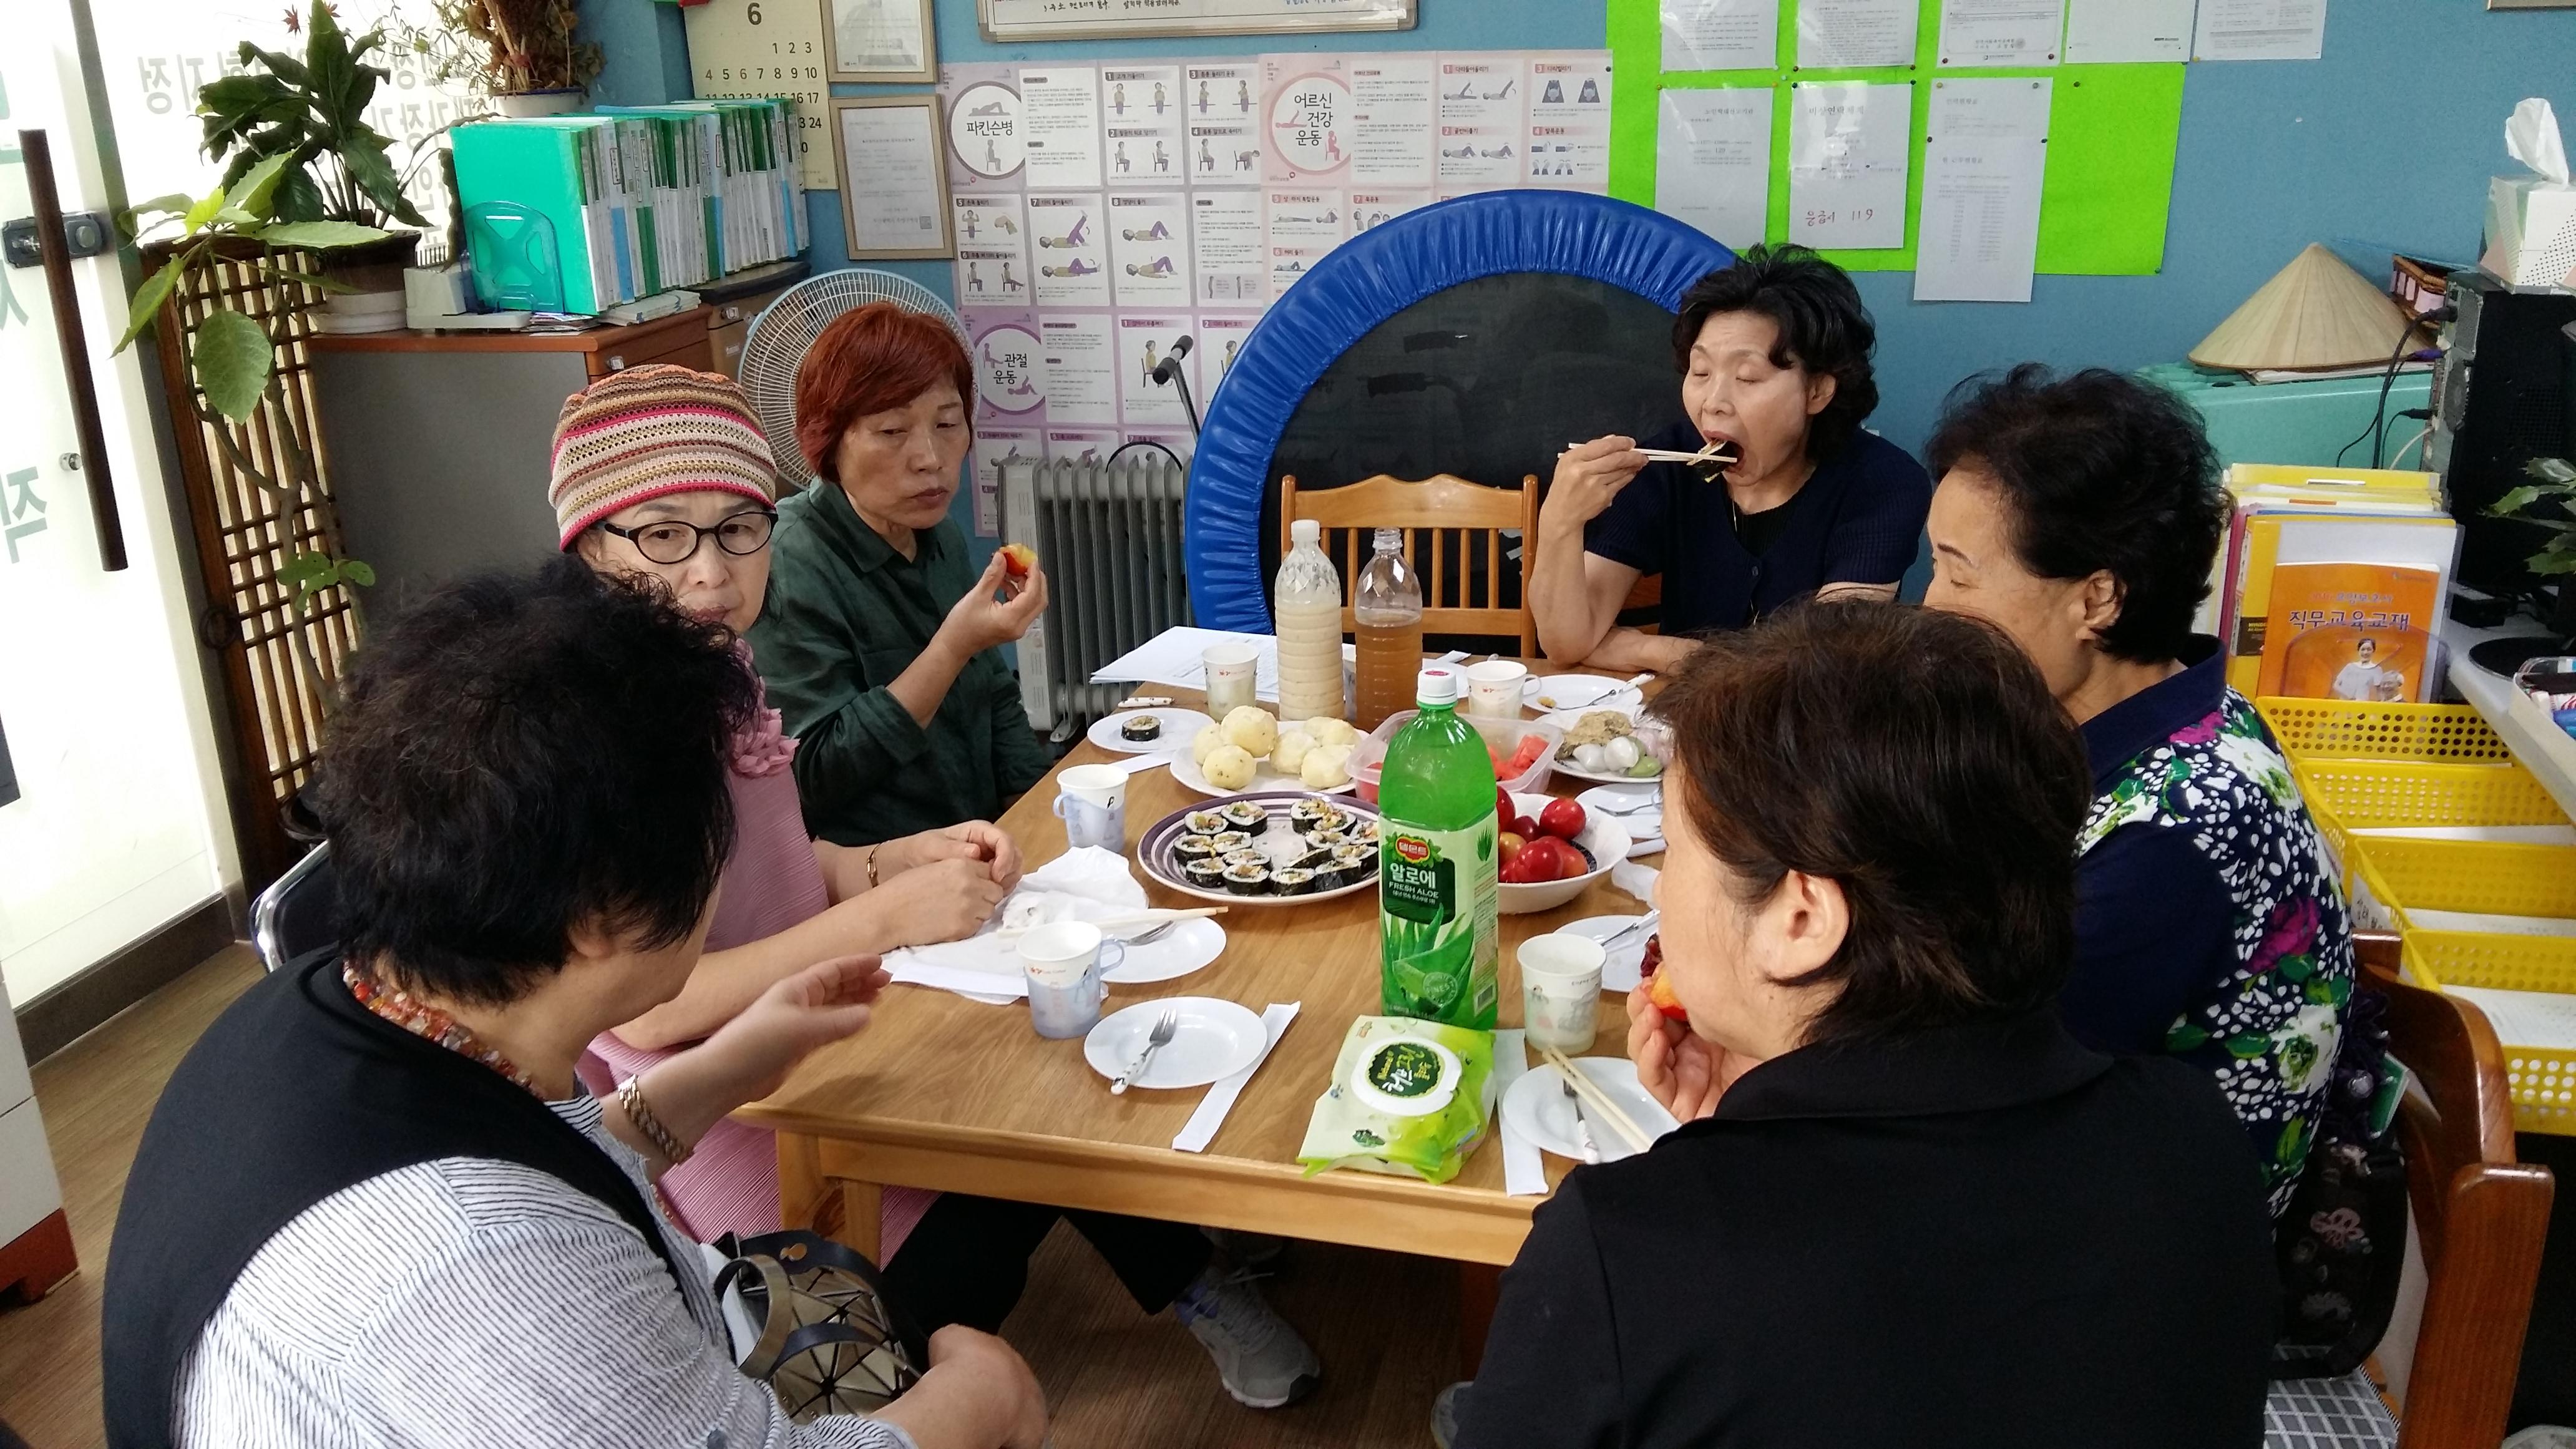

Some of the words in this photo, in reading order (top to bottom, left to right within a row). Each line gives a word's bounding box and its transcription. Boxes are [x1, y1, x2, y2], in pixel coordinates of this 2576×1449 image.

[748, 2, 762, 25] 6
[772, 43, 778, 54] 1
[788, 42, 796, 54] 2
[805, 42, 812, 53] 3
[705, 69, 713, 80] 4
[723, 69, 729, 80] 5
[739, 69, 747, 79] 6
[756, 68, 764, 79] 7
[774, 67, 781, 79] 8
[791, 67, 798, 79] 9
[804, 67, 817, 79] 10
[807, 92, 819, 103] 17
[1294, 92, 1332, 109] 어르신
[809, 117, 822, 129] 24
[1307, 111, 1333, 128] 건강
[967, 120, 1013, 136] 파킨슨병
[1295, 130, 1322, 146] 운동
[1852, 208, 1873, 221] 119
[1004, 353, 1028, 368] 관절
[993, 370, 1017, 385] 운동
[2289, 609, 2411, 632] 직무교육교재
[1390, 862, 1436, 889] 알로에
[1388, 881, 1415, 894] FRESH
[1417, 888, 1439, 899] ALOE
